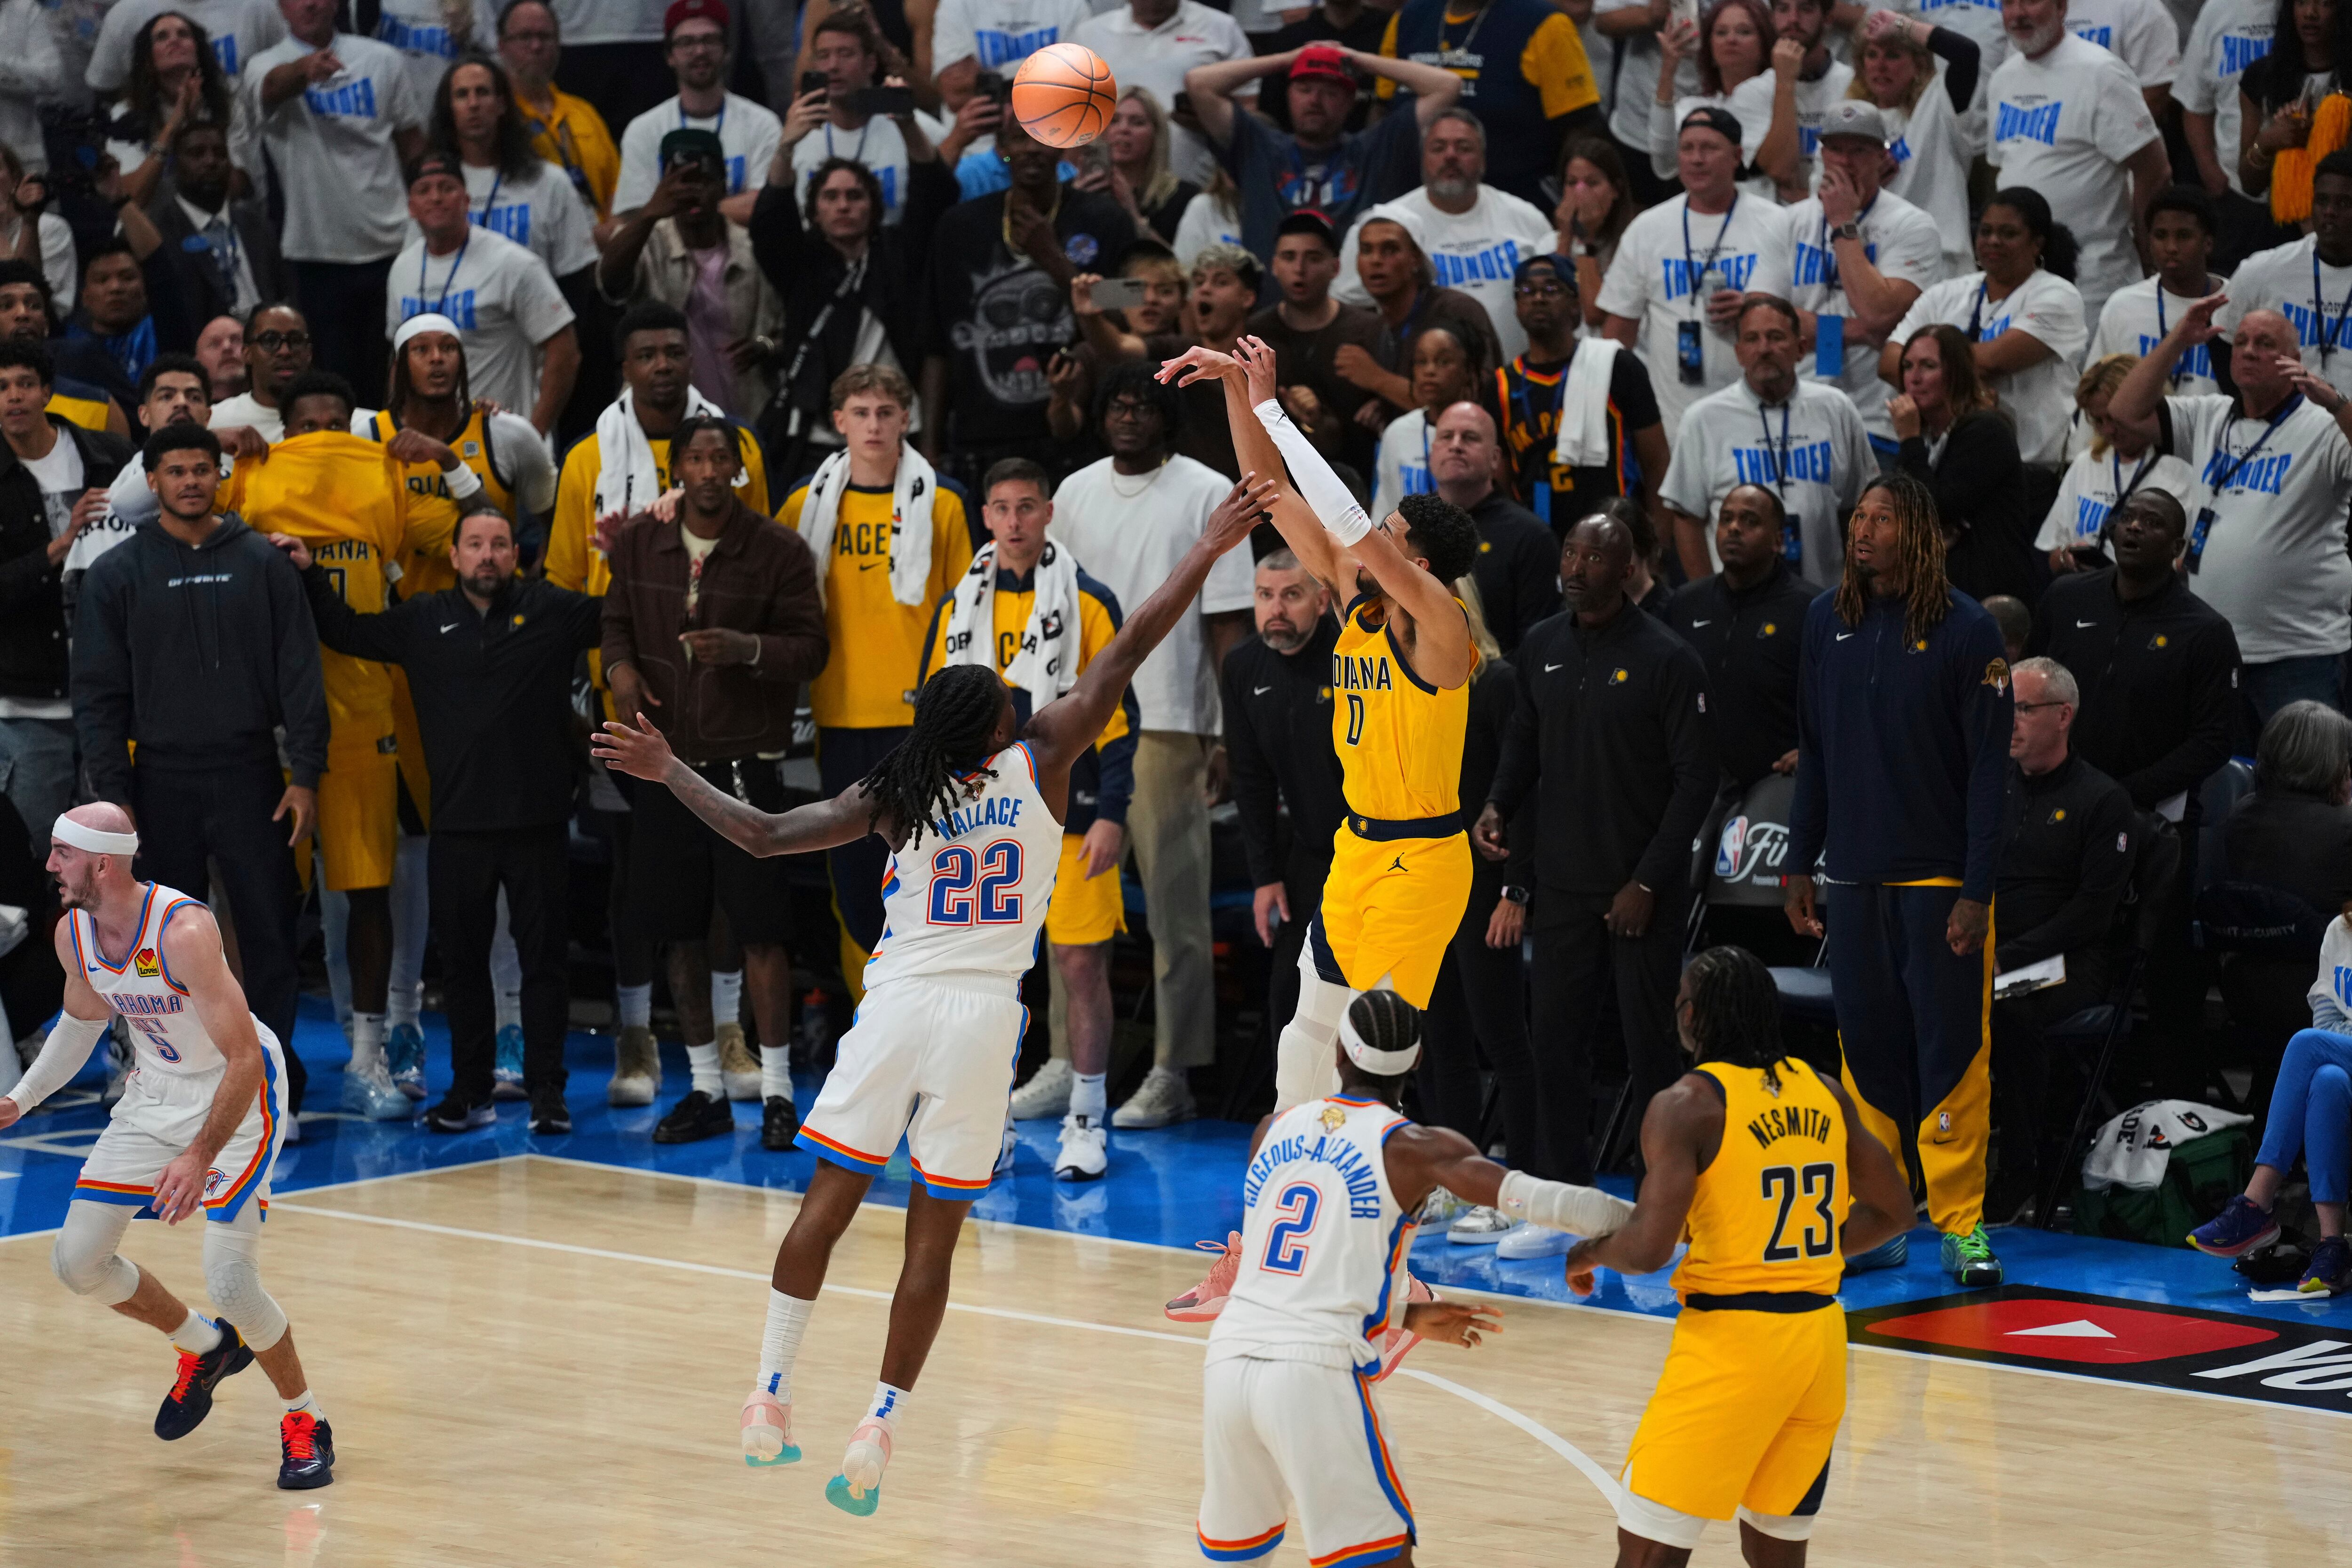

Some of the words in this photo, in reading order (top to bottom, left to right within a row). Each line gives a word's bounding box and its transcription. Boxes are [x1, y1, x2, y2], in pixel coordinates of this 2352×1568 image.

[1346, 693, 1364, 747] 0
[935, 797, 1023, 841] WALLACE
[926, 839, 1024, 925] 22
[143, 1032, 182, 1063] 9
[1748, 1106, 1831, 1150] NESMITH
[1245, 1134, 1381, 1219] GILGEOUS-ALEXANDER
[1260, 1181, 1322, 1276] 2
[1761, 1161, 1836, 1263] 23
